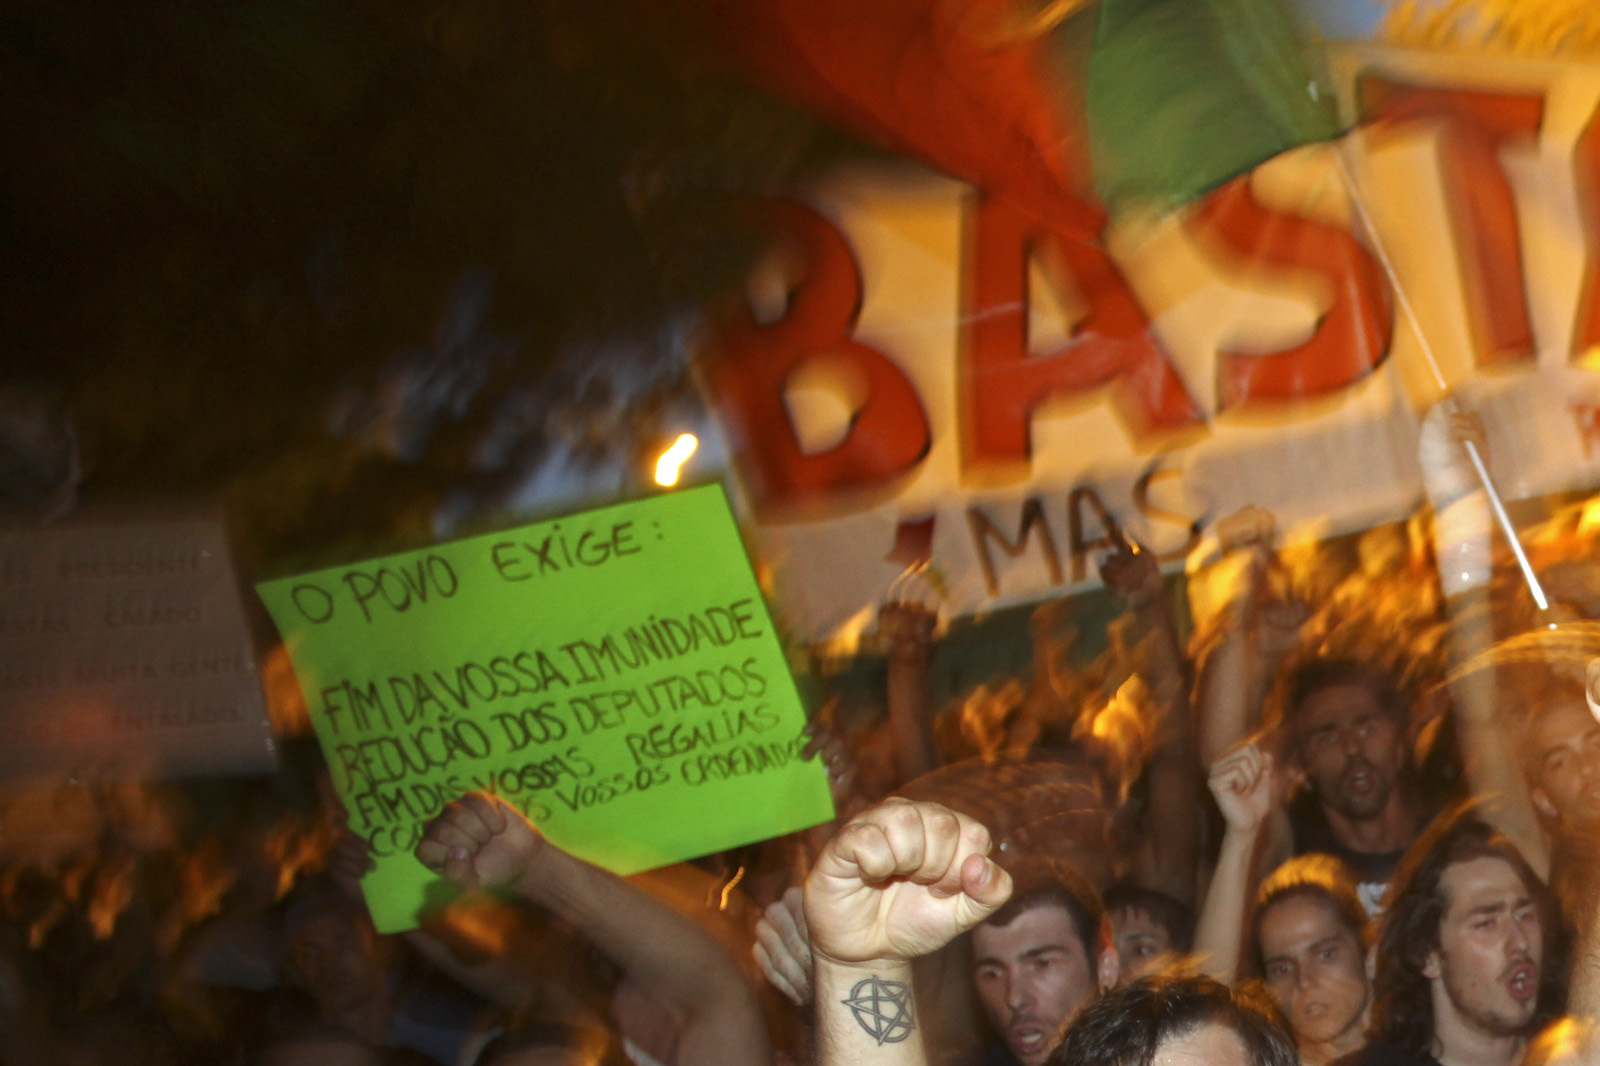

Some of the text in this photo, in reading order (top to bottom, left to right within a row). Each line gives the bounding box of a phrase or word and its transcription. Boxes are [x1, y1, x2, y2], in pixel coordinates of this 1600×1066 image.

[965, 462, 1202, 598] MAS
[290, 583, 335, 624] O
[342, 554, 458, 624] POVO
[320, 598, 763, 735] FIM DA VOSSA IMUNIDADE
[336, 657, 767, 794] REDUÇÃO DOS DEPUTADOS
[625, 703, 780, 766] REGALIAS
[555, 763, 671, 812] VOSSOS
